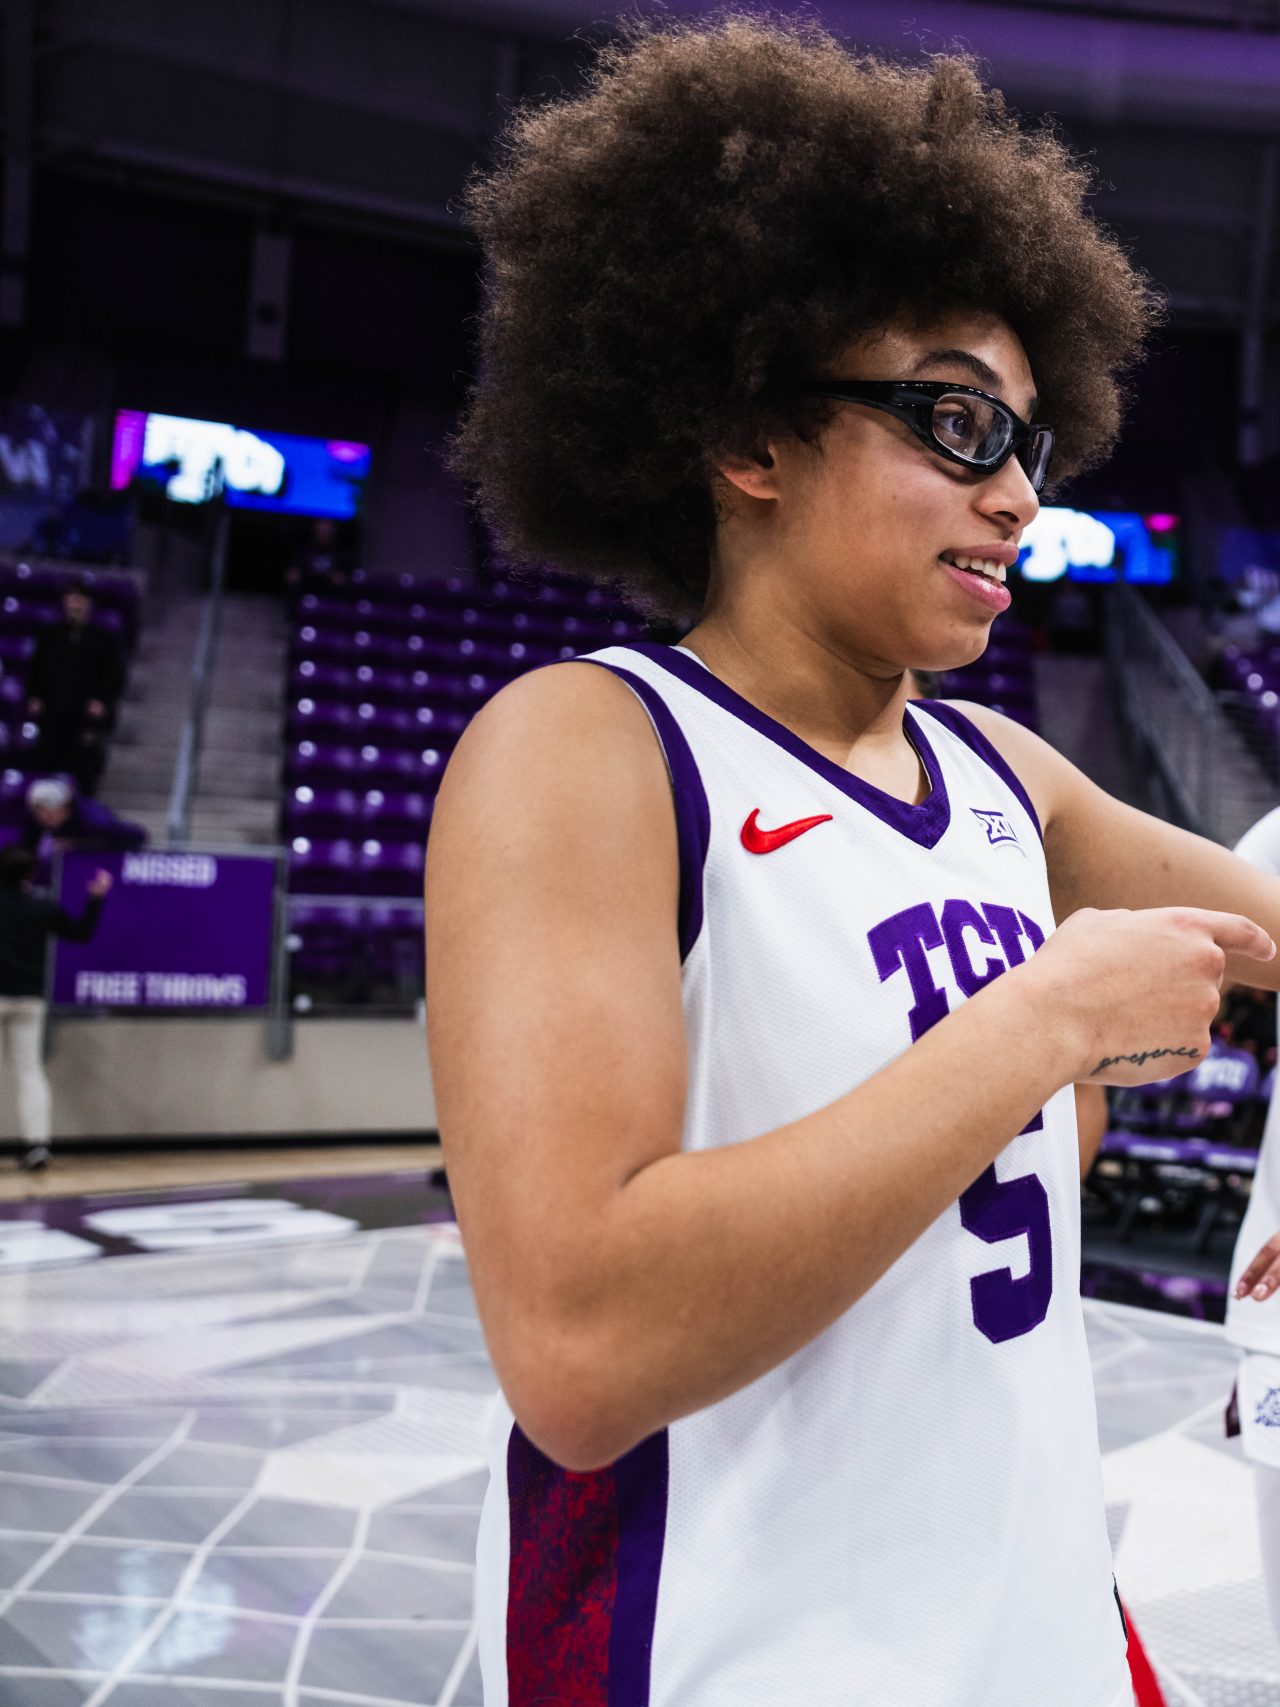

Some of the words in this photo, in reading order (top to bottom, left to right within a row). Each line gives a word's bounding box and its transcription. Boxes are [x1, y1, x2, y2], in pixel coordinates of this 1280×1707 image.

[122, 852, 217, 888] MISSED
[75, 970, 140, 1005] FREE
[144, 971, 248, 1007] THROWS
[1089, 1046, 1200, 1076] presence
[957, 1107, 1054, 1345] 5
